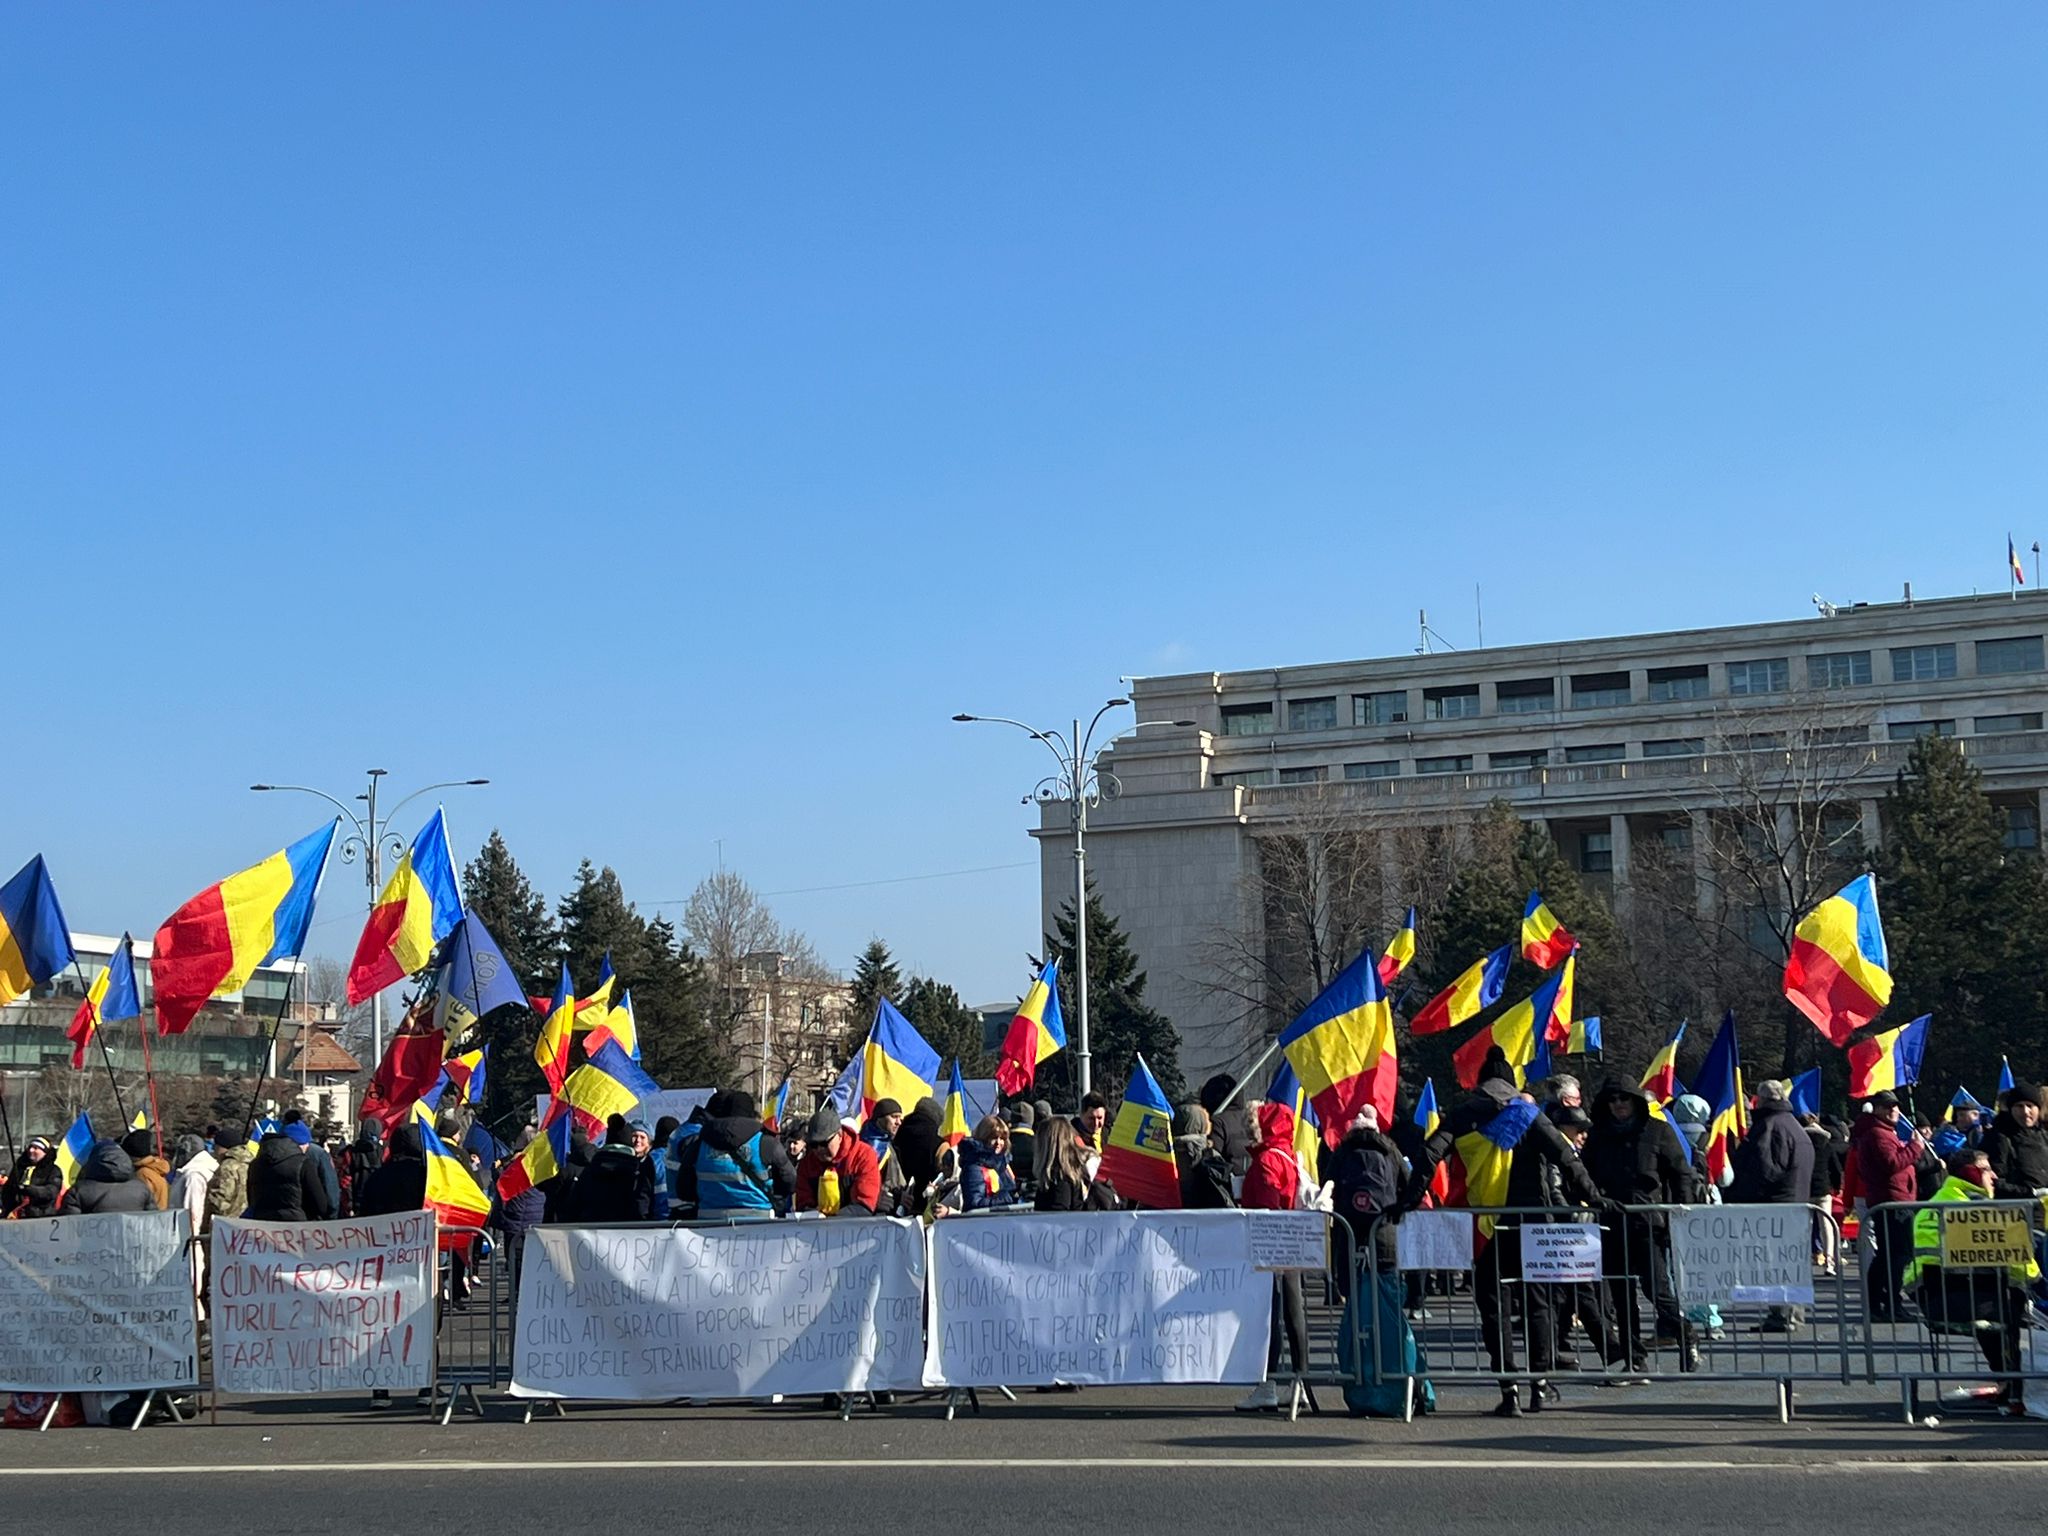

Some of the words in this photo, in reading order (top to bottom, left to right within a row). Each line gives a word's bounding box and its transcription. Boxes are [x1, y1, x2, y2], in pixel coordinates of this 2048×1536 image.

[49, 1219, 60, 1242] 2
[1687, 1217, 1784, 1240] CIOLACU
[1970, 1229, 2007, 1244] ESTE
[947, 1228, 1016, 1269] COPIII
[1676, 1243, 1721, 1266] VINO
[1949, 1244, 2032, 1264] NEDREAPTĂ
[220, 1260, 285, 1299] CIUMA
[822, 1263, 884, 1294] ATUNCI
[1025, 1272, 1070, 1302] COPIII
[1685, 1271, 1705, 1289] TE
[223, 1301, 286, 1332] TURUL
[289, 1299, 303, 1331] 2
[695, 1305, 772, 1334] POPORUL
[783, 1303, 819, 1327] MEU
[878, 1295, 921, 1322] TOATE
[980, 1317, 1040, 1355] FURAT
[1052, 1312, 1120, 1346] PENTRU
[1129, 1311, 1146, 1339] AI
[526, 1350, 632, 1380] RESURSELE
[970, 1355, 993, 1378] NOI
[1087, 1347, 1107, 1372] PE
[1112, 1345, 1128, 1370] AI
